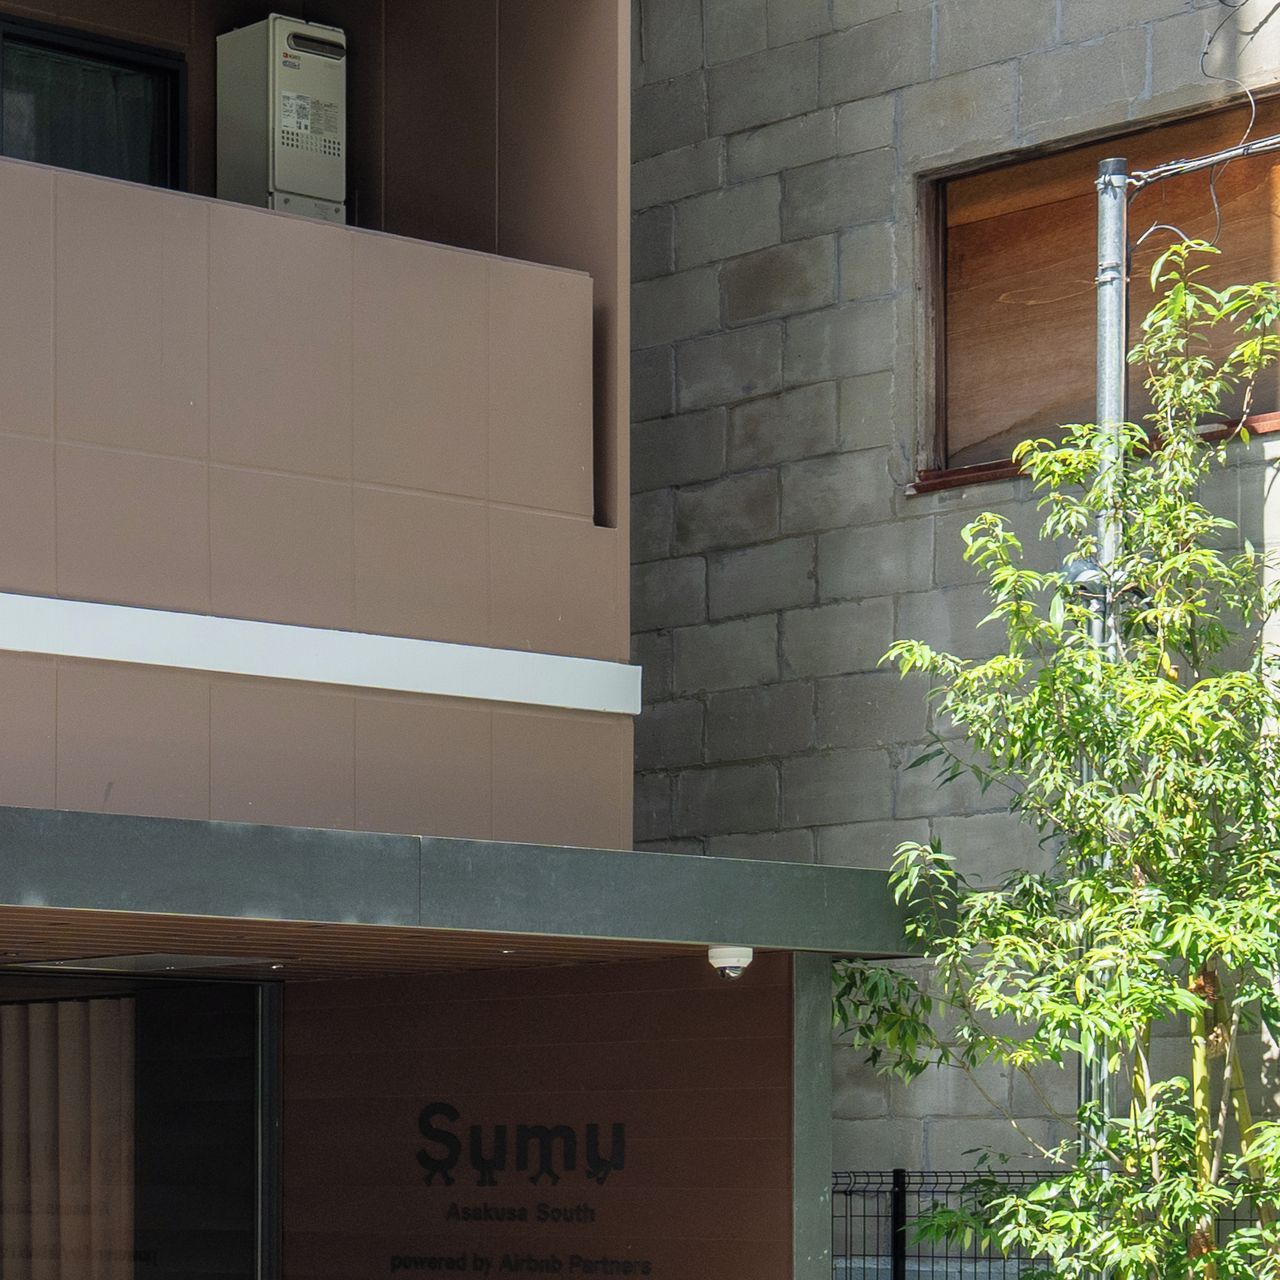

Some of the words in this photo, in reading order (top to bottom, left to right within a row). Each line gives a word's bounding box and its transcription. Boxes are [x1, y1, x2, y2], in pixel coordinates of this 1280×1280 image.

[416, 1101, 625, 1187] Sumu
[447, 1202, 528, 1223] Asakusa
[536, 1203, 596, 1223] South
[390, 1253, 466, 1273] powered
[473, 1253, 493, 1276] by
[499, 1254, 563, 1273] Airbnb
[569, 1255, 653, 1276] Partners
